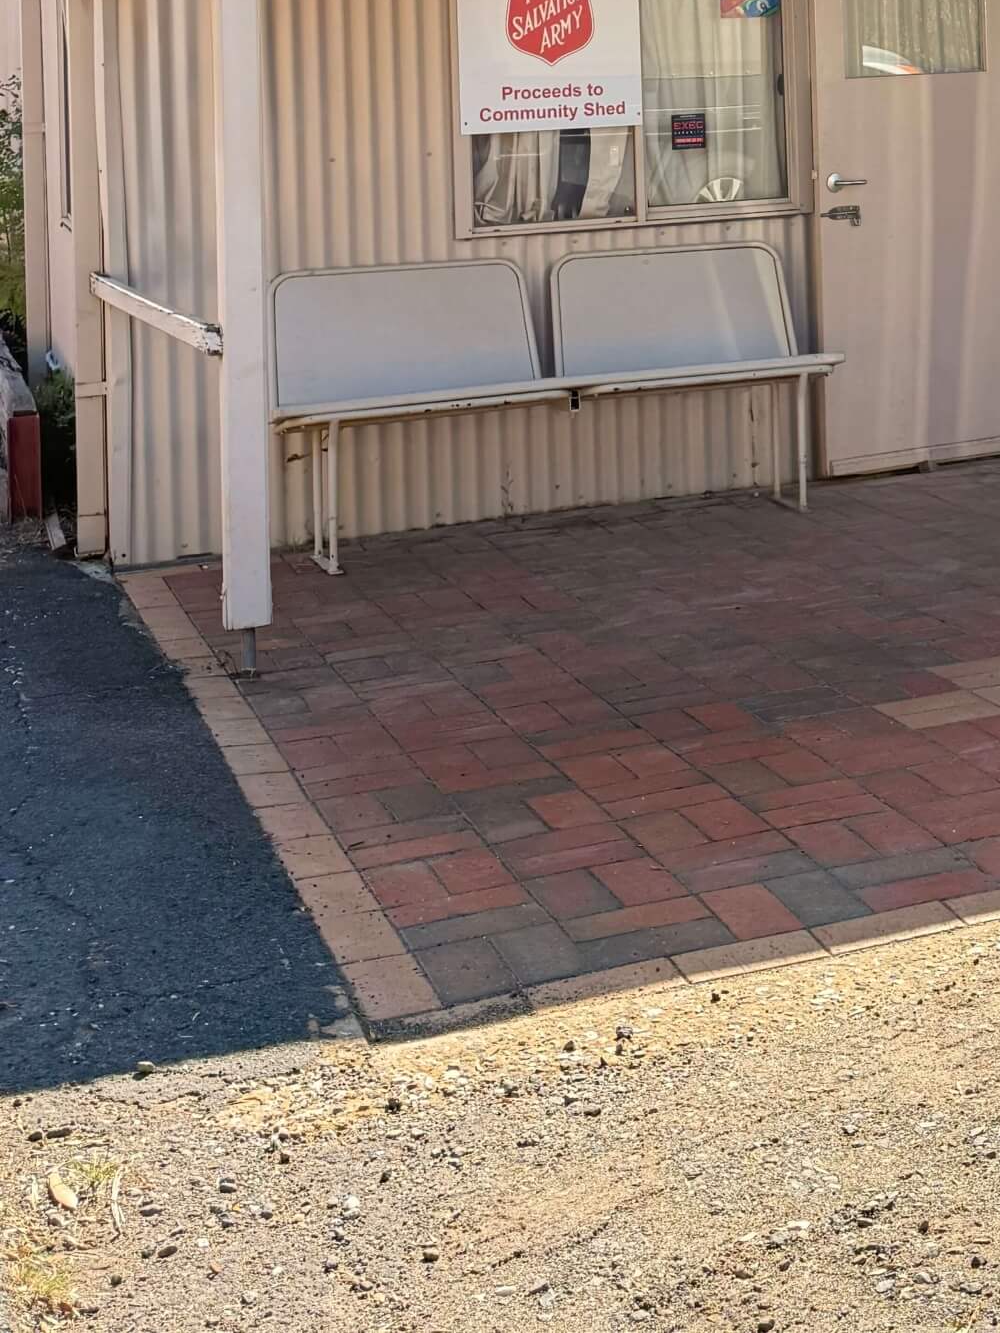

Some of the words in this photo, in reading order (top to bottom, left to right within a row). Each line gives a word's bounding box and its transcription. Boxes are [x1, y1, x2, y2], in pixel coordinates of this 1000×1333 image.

[539, 5, 583, 54] ARMY
[501, 84, 582, 101] Proceeds
[587, 83, 604, 96] to
[479, 104, 578, 122] Community
[583, 101, 626, 116] Shed
